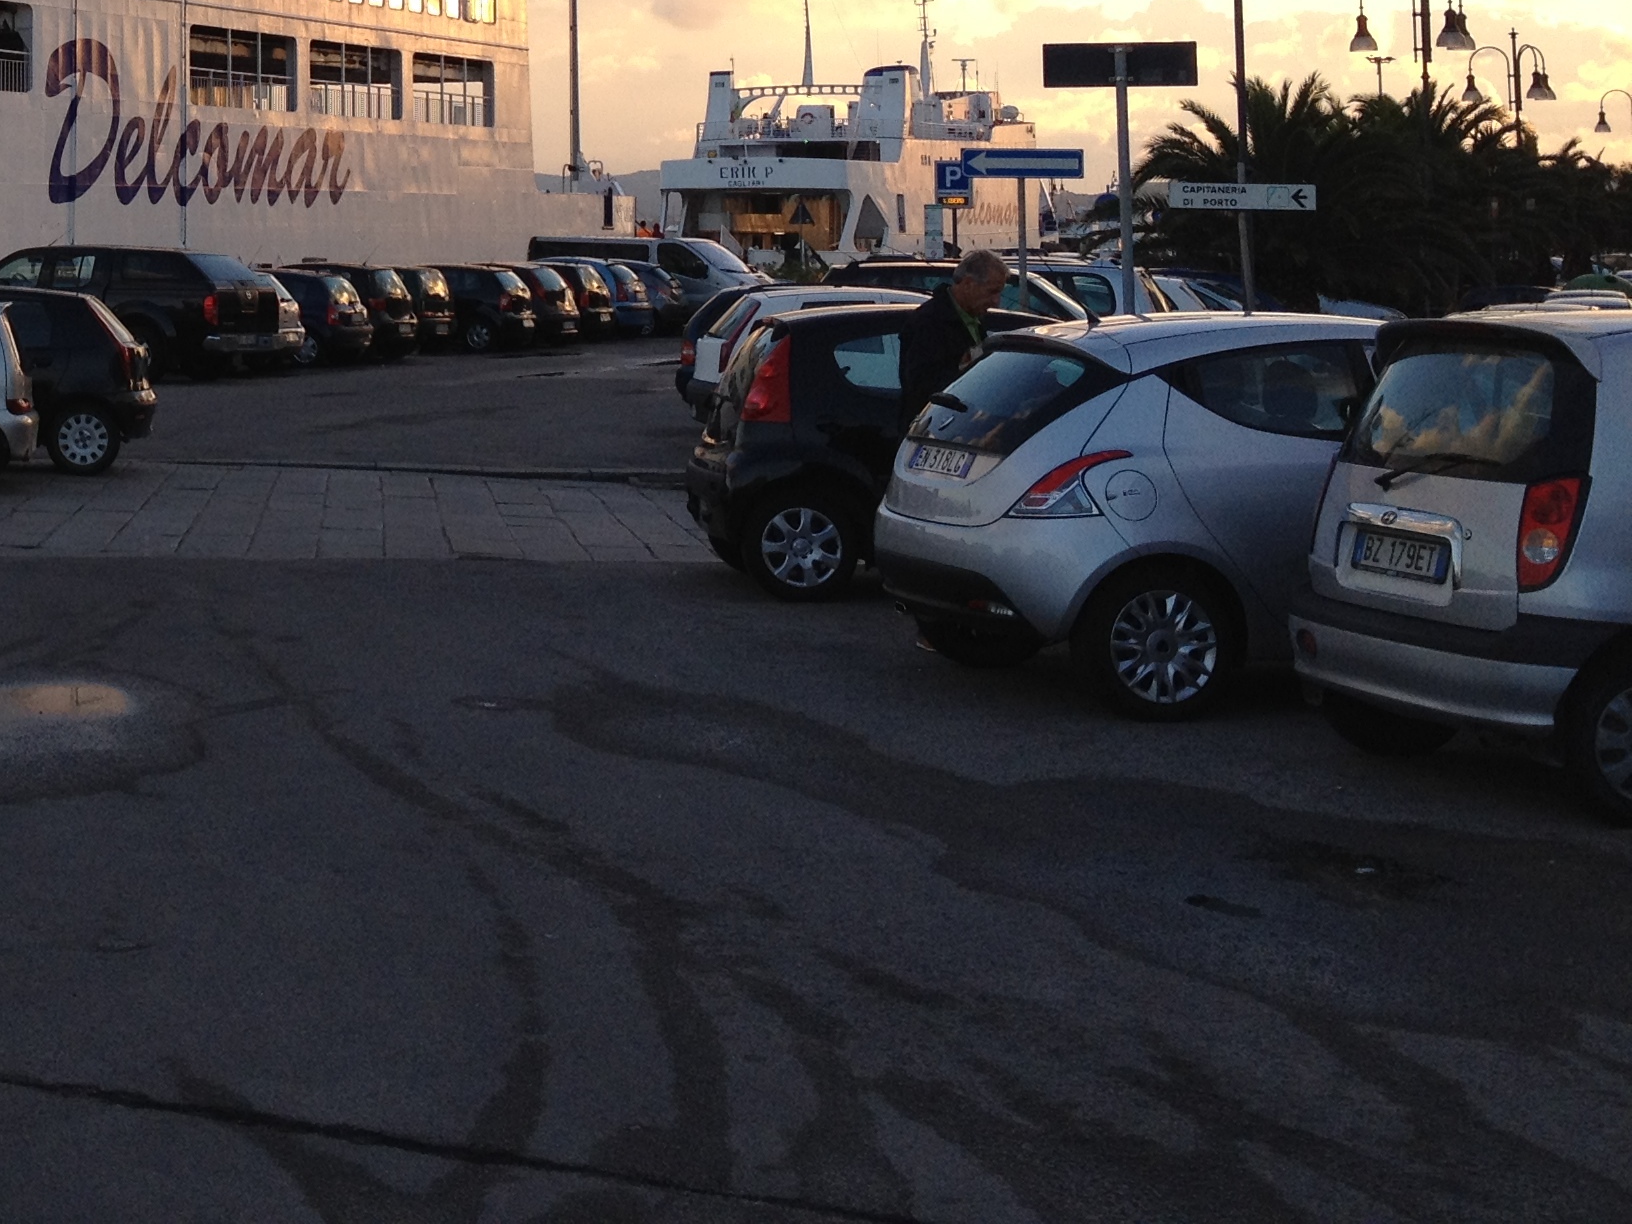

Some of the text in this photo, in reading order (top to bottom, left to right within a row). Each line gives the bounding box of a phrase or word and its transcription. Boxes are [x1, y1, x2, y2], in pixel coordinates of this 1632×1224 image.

[45, 38, 351, 208] Delcomar
[720, 166, 774, 179] ERIK P
[945, 166, 962, 188] P
[1182, 185, 1247, 194] CAPITANERIA
[958, 187, 1018, 226] elcomar
[1182, 198, 1238, 207] DI PORTO
[1363, 536, 1437, 573] BZ 179ET
